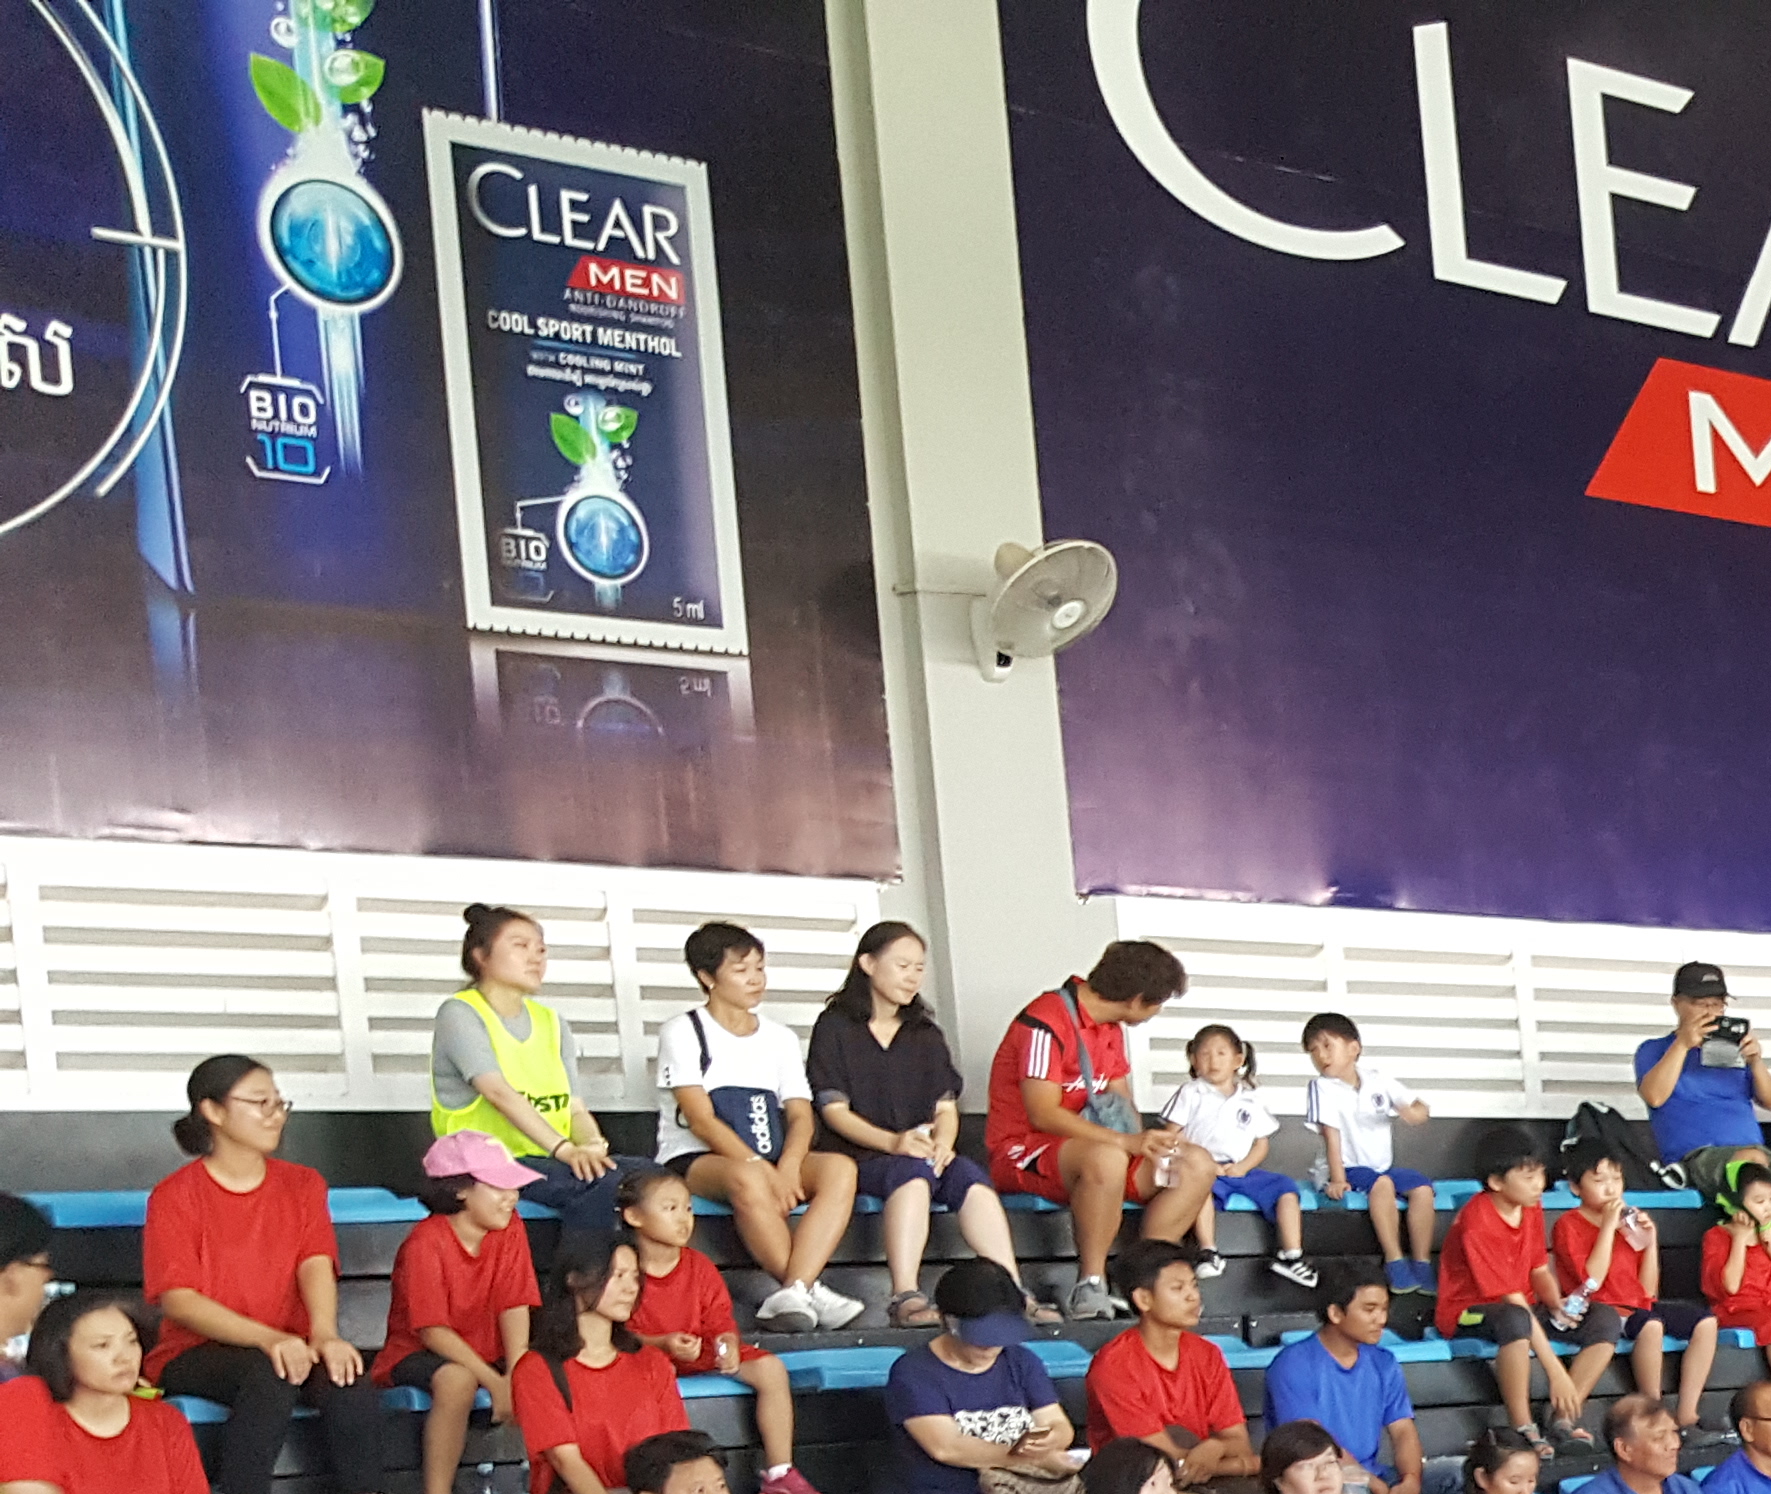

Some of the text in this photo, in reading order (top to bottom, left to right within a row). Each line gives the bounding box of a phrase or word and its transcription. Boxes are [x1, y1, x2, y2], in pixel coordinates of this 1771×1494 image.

[468, 162, 681, 266] CLEAR
[588, 263, 679, 300] MEN
[487, 309, 683, 358] COOL SPORT MENTHOL
[249, 389, 317, 425] BIO
[257, 434, 317, 475] 10
[501, 537, 548, 562] BIO
[672, 597, 683, 618] 5
[749, 1093, 772, 1154] adidas
